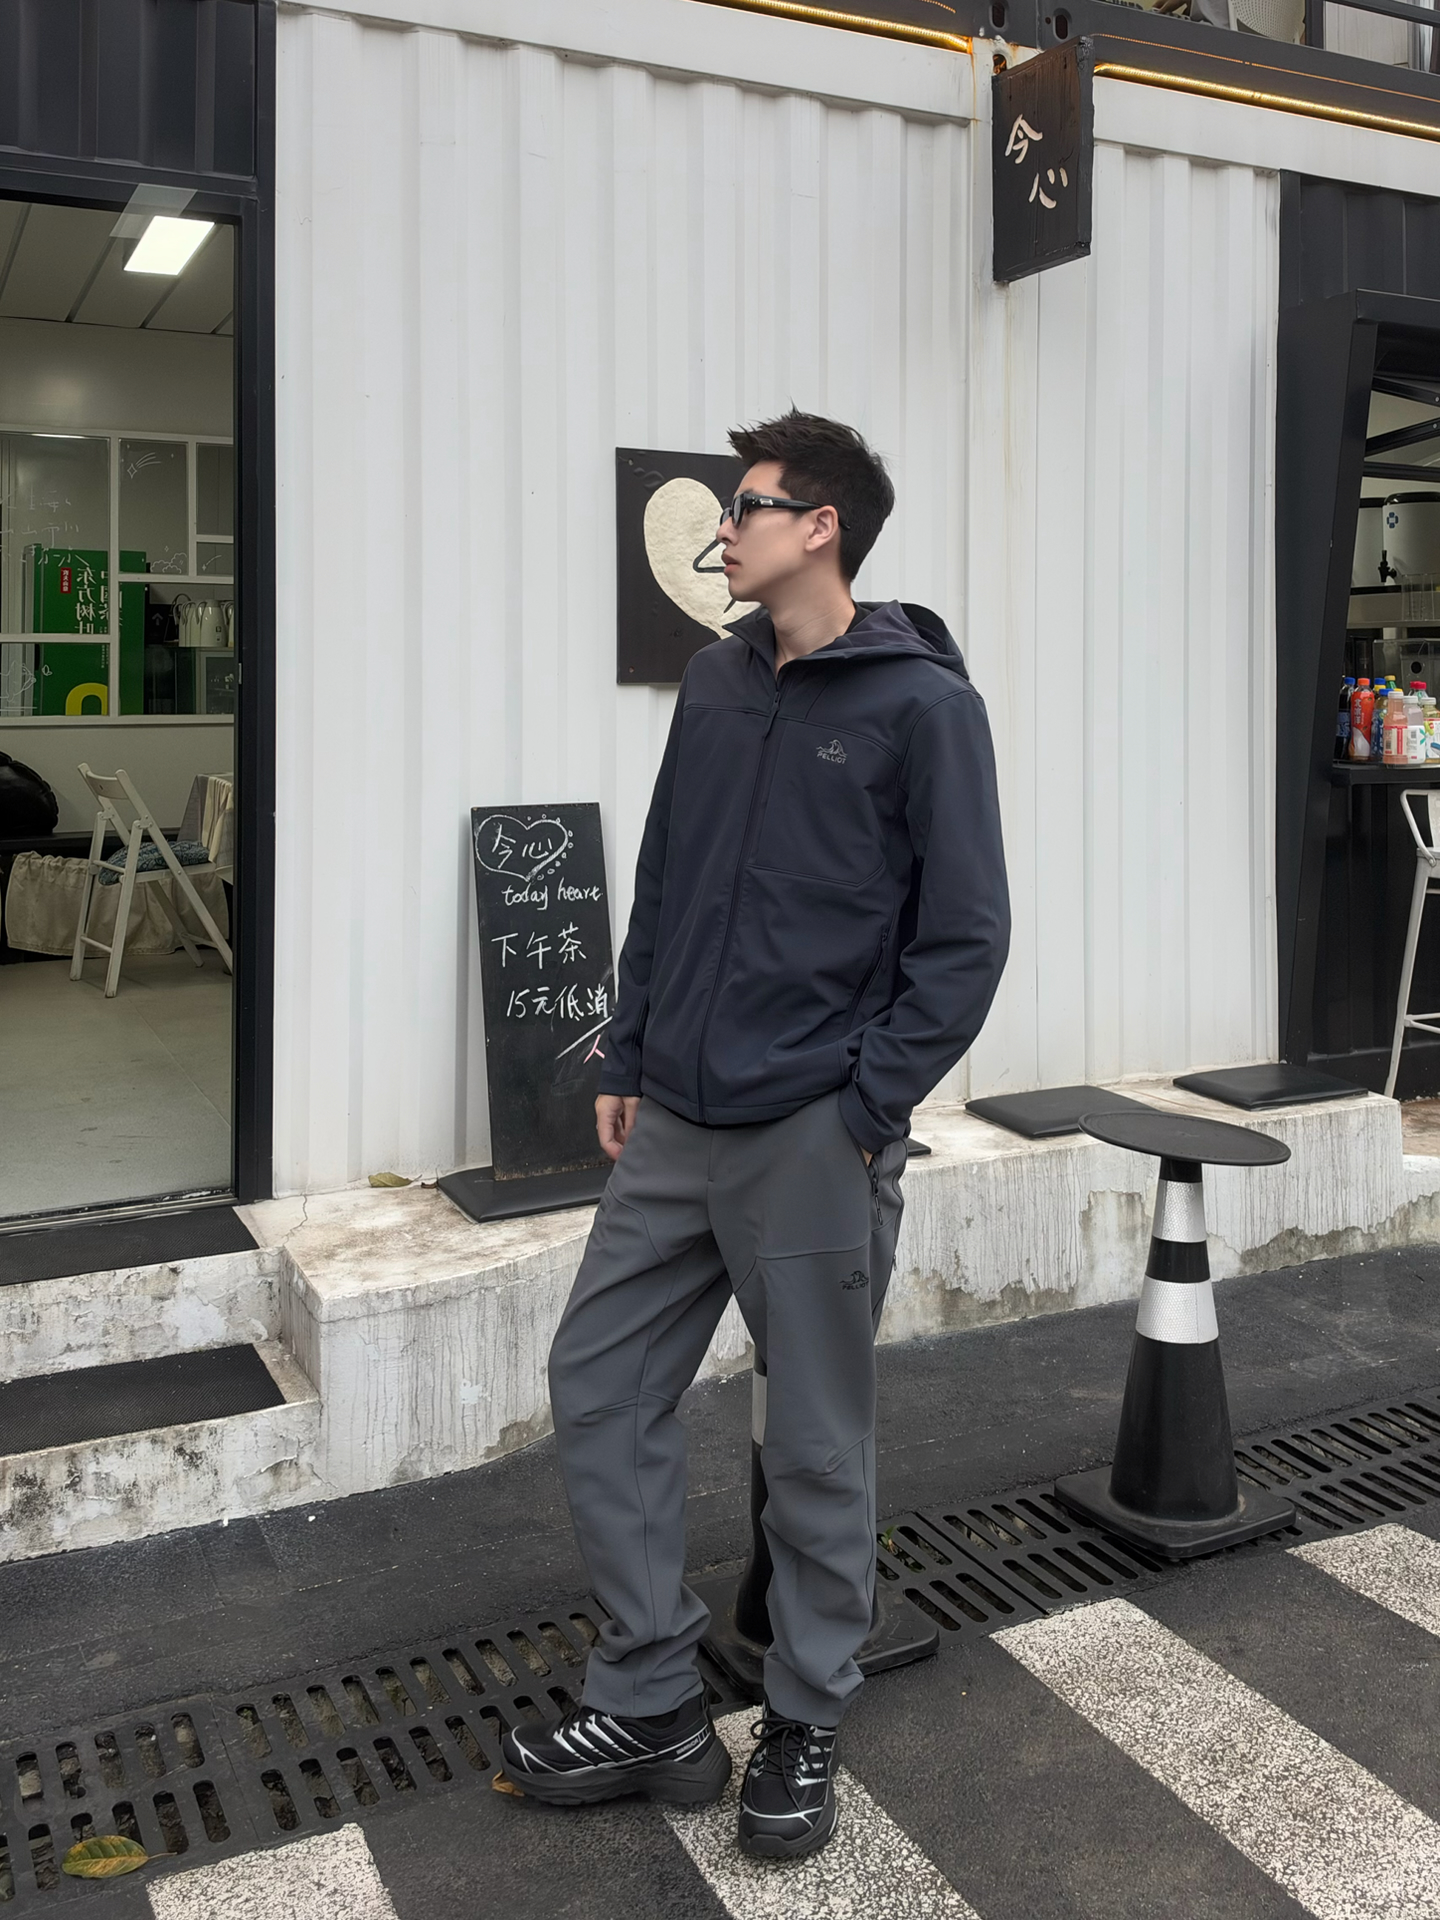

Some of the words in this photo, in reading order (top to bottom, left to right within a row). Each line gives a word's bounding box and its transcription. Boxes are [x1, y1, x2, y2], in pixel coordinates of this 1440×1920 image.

[1005, 114, 1069, 210] 今心
[492, 824, 553, 869] 今心
[501, 882, 548, 911] today
[557, 877, 603, 902] heart
[491, 922, 586, 969] 下午茶
[507, 983, 608, 1022] 15元低消
